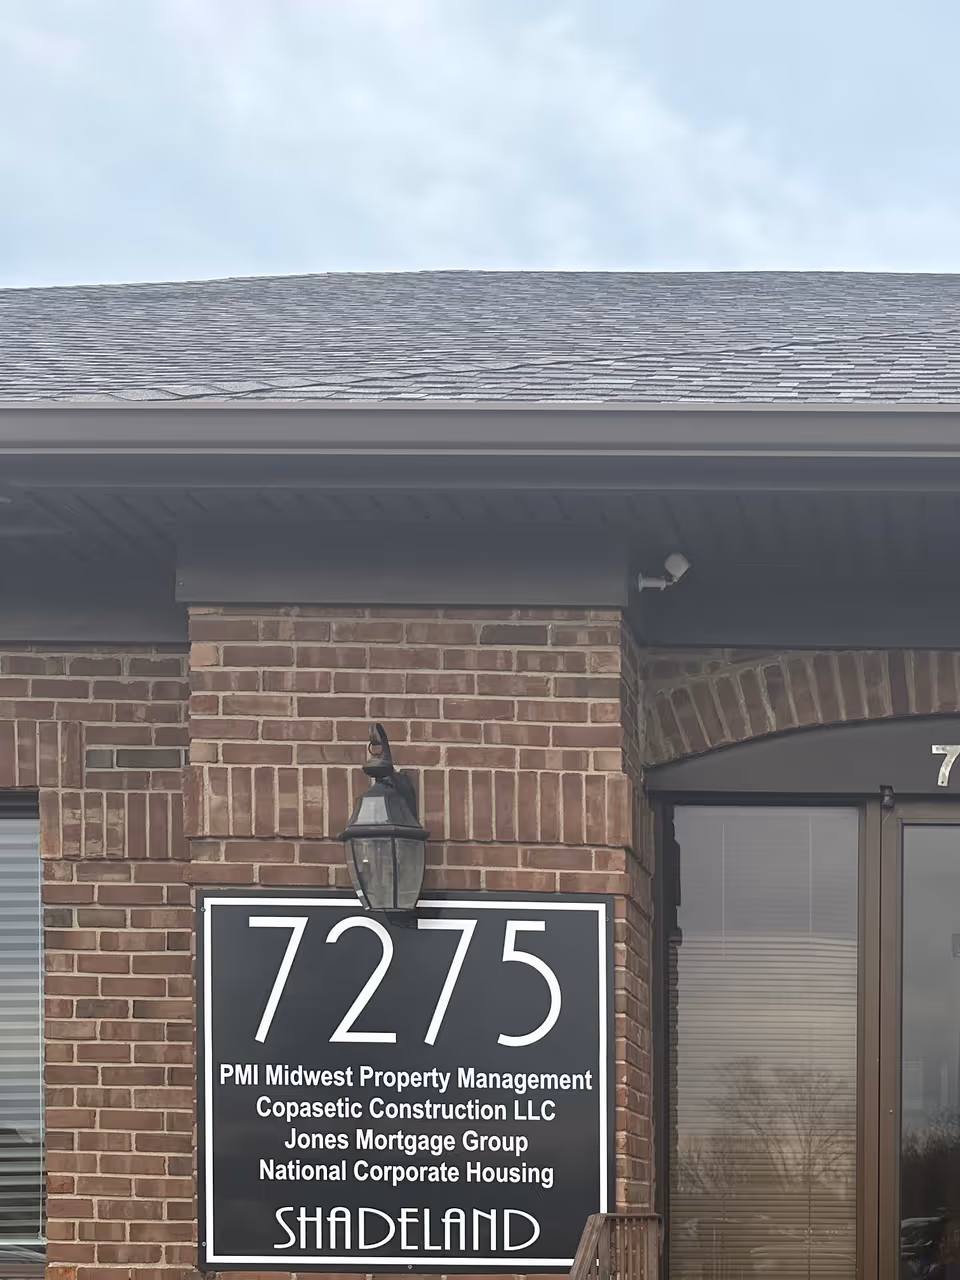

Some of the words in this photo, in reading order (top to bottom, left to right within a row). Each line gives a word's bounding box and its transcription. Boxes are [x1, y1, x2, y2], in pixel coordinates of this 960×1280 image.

[248, 915, 562, 1047] 7275
[220, 1064, 258, 1086] PMI
[266, 1065, 353, 1087] Midwest
[360, 1066, 450, 1093] Property
[457, 1068, 592, 1095] Management
[257, 1096, 363, 1121] Copasetic
[369, 1098, 506, 1120] Construction
[514, 1100, 555, 1121] LLC
[284, 1129, 348, 1149] Jones
[356, 1129, 455, 1156] Mortgage
[462, 1132, 529, 1155] Group
[259, 1160, 346, 1181] National
[354, 1161, 459, 1186] Corporate
[466, 1162, 554, 1188] Housing
[273, 1206, 540, 1251] SHADELAND
